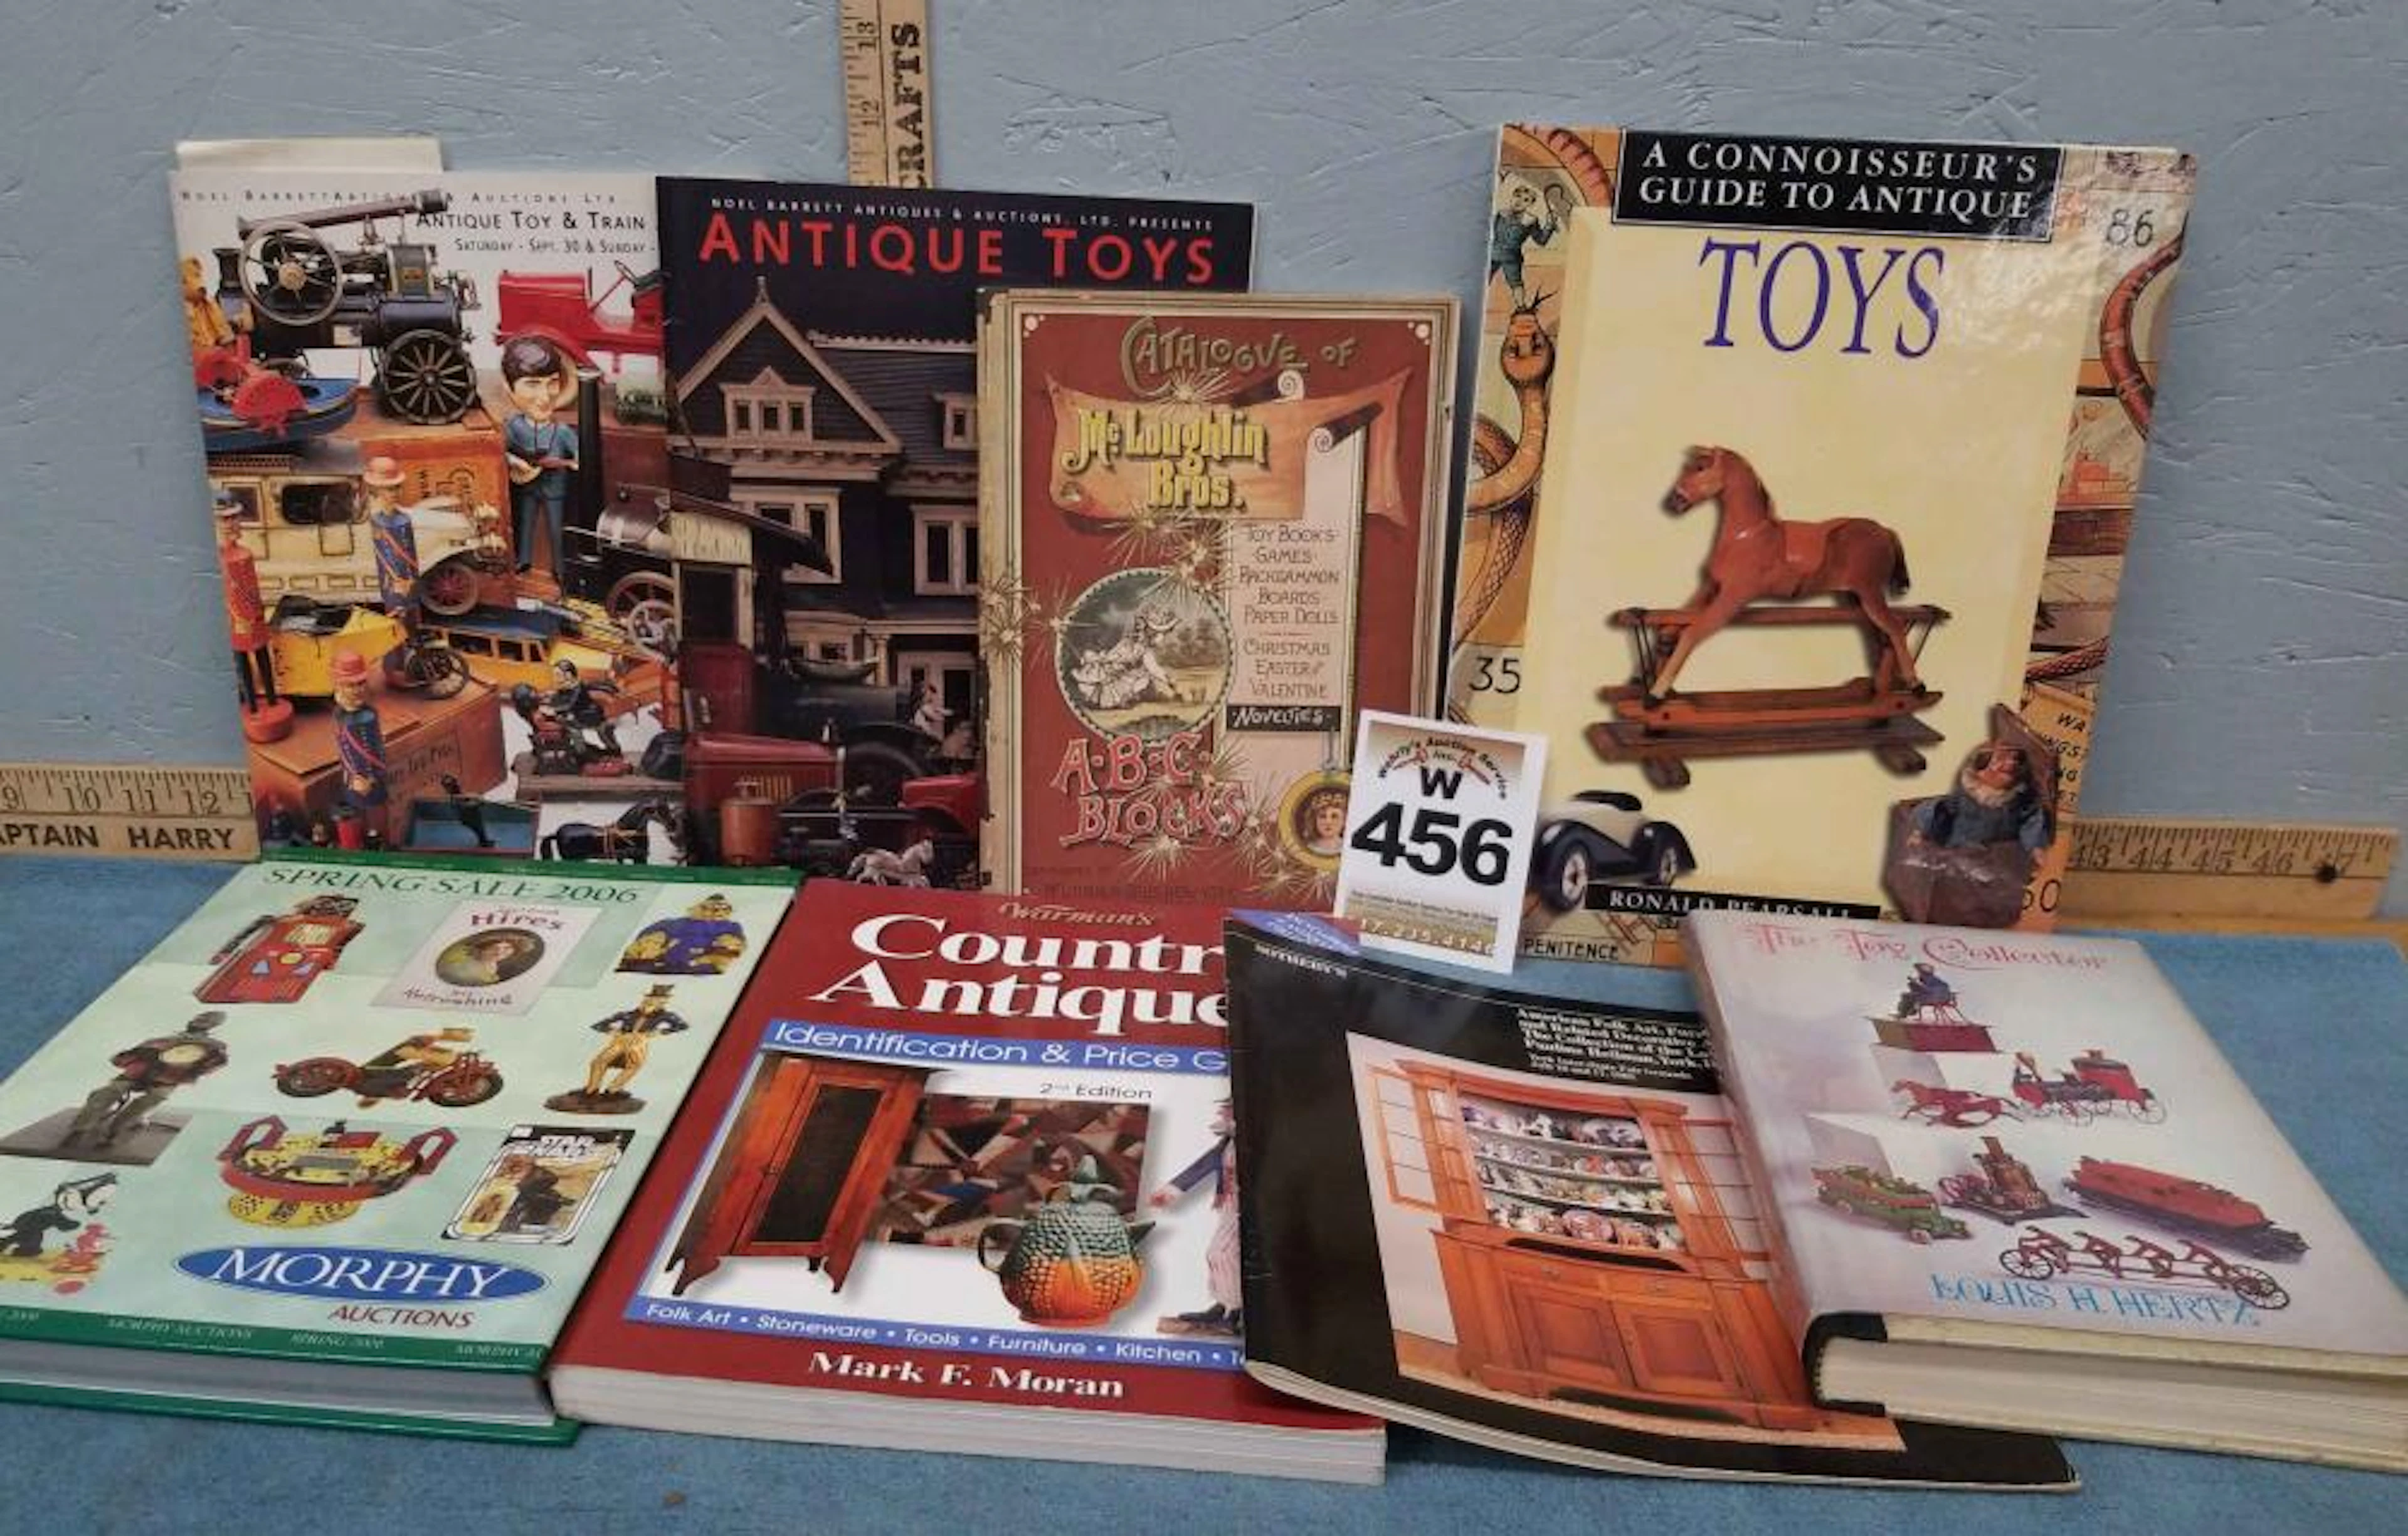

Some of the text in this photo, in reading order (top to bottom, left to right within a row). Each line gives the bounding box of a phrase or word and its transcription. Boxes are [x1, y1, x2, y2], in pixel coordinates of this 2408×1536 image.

[1642, 142, 2039, 181] A CONNOISSEUR'S
[1639, 176, 2033, 221] GUIDE TO ANTIQUE
[416, 211, 646, 229] ANTIQUE TOY & TRAIN
[2106, 208, 2153, 248] 86
[698, 212, 1215, 284] ANTIQUE TOYS
[1700, 237, 1945, 359] TOYS
[1469, 656, 1521, 694] 35
[63, 787, 102, 811] 10
[124, 789, 159, 813] 11
[183, 790, 222, 815] 12
[1420, 765, 1464, 799] W
[1059, 781, 1246, 848] BLOCKS
[0, 824, 235, 850] PTAIN HARRY
[1351, 802, 1513, 886] 456
[2130, 846, 2173, 870] 44
[2192, 848, 2235, 873] 45
[2252, 851, 2294, 875] 46
[261, 868, 640, 903] SPRING SALE 2006
[1608, 890, 1714, 912] RONALD
[850, 913, 1225, 976] Countr
[1524, 940, 1619, 960] PENITENCE
[805, 959, 1229, 1036] Antique
[774, 1022, 1228, 1071] Identification & Price G
[1075, 1083, 1154, 1100] Edition
[213, 1248, 509, 1298] MORPHY
[327, 1305, 475, 1328] AUCTIONS
[645, 1303, 689, 1323] Folk
[693, 1308, 732, 1326] Art
[757, 1313, 879, 1340] Stoneware
[905, 1327, 961, 1347] Tools
[988, 1333, 1087, 1355] Furniture
[1115, 1340, 1201, 1364] Kitchen
[808, 1351, 925, 1385] Mark
[988, 1365, 1125, 1398] Moran
